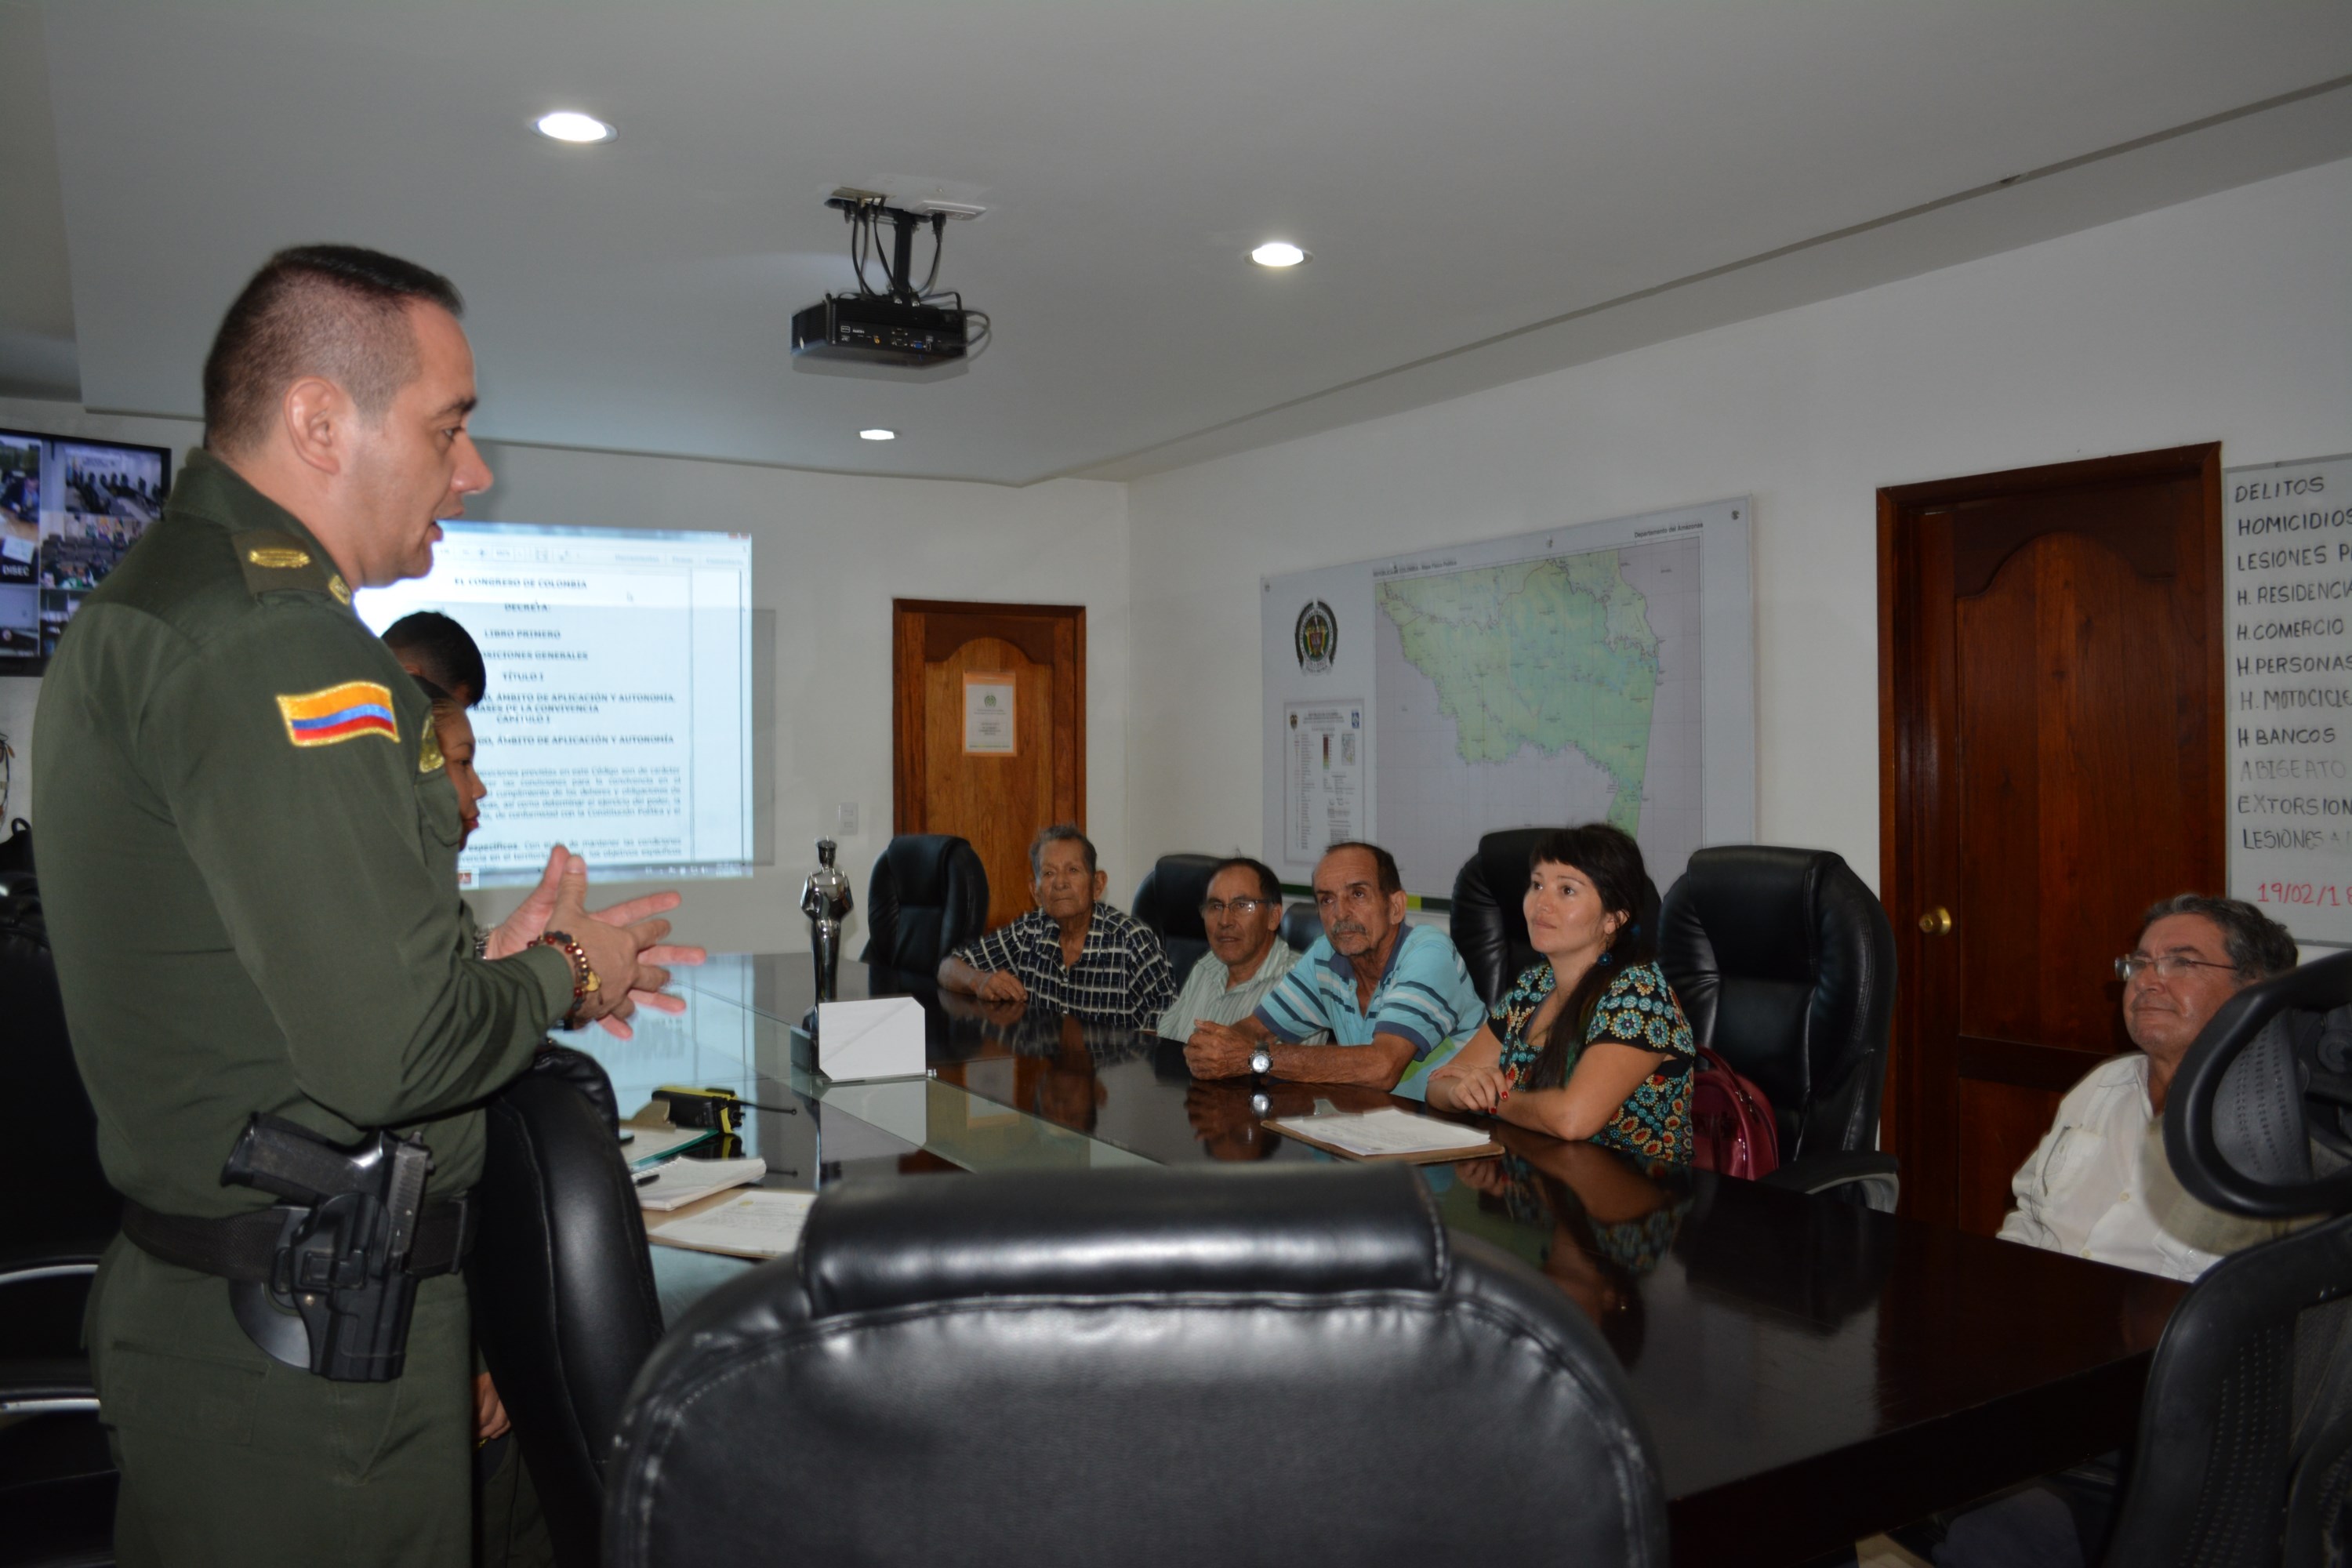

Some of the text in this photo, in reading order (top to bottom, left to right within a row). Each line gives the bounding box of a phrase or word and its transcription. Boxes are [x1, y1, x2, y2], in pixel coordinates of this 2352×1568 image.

[2235, 477, 2325, 503] DELITOS
[1634, 528, 1668, 539] Departamento
[1677, 522, 1704, 532] Amazonas
[2237, 543, 2352, 571] LESIONES P
[2, 564, 30, 577] DISEC
[455, 577, 588, 588] EL CONGRESO DE COLOMBIA
[485, 630, 561, 640] LIBRO PRIMERO
[535, 651, 588, 660] GENERALES
[503, 671, 537, 681] TÍTULO
[537, 693, 549, 702] DE
[551, 691, 608, 702] APLICACIÓN
[535, 704, 599, 713] CONVIVENCIA
[537, 736, 549, 745] DE
[551, 734, 608, 746] APLICACIÓN
[611, 735, 617, 744] Y
[619, 733, 674, 745] AUTONOMÍA
[2256, 728, 2336, 745] BANCOS
[2238, 795, 2352, 816] EXTORSION
[2243, 829, 2324, 850] LESIONES
